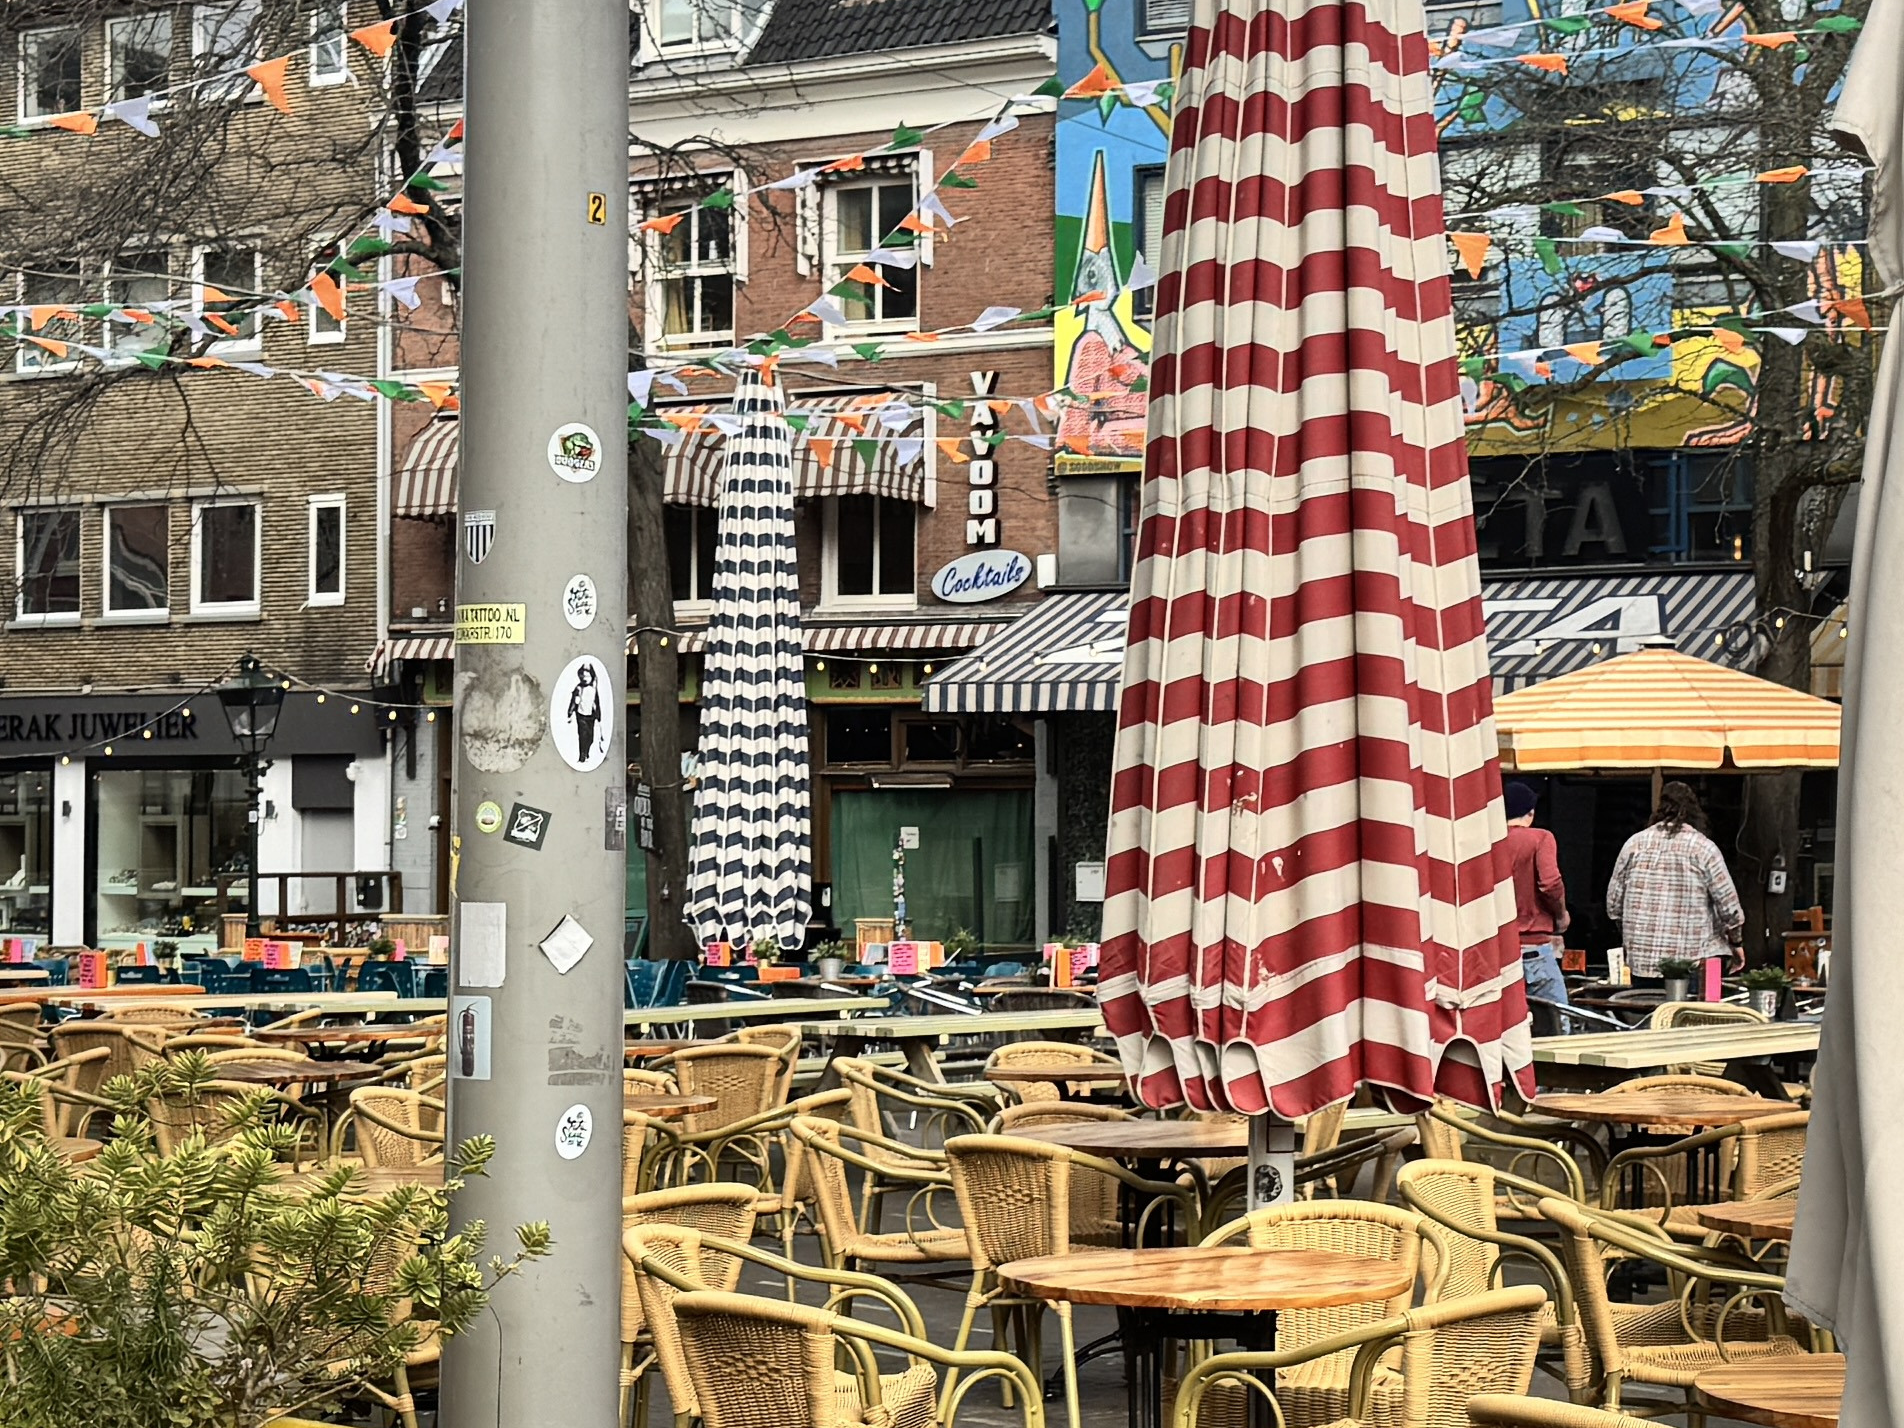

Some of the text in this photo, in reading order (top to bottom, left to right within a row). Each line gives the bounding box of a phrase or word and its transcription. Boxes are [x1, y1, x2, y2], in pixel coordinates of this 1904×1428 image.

[966, 370, 996, 545] VAVOOM
[942, 556, 1023, 598] Cocktails
[67, 711, 198, 741] JUWELIER
